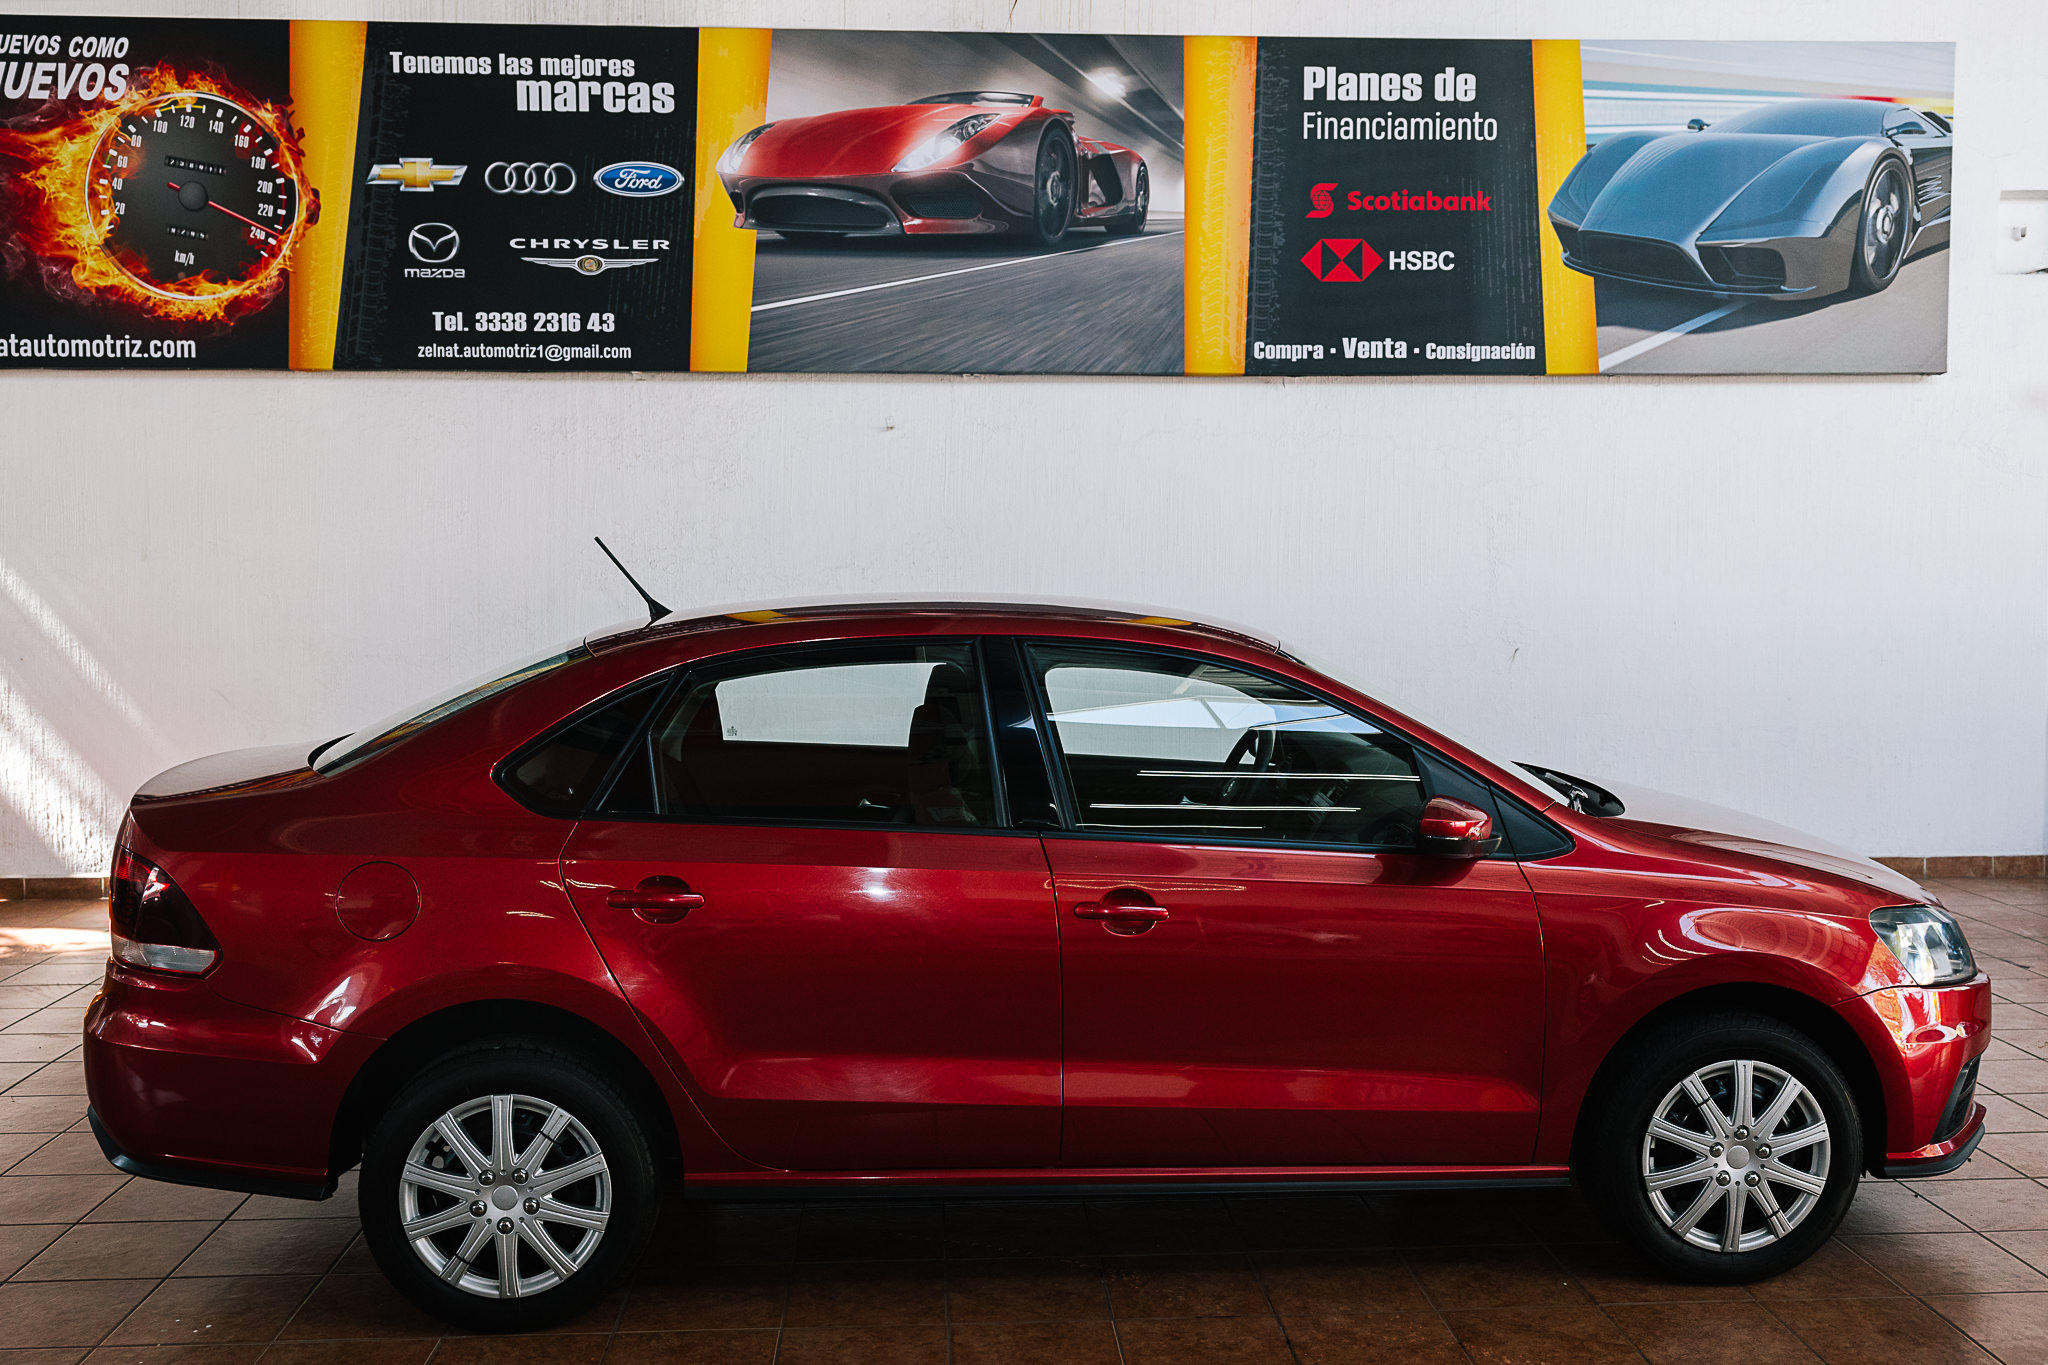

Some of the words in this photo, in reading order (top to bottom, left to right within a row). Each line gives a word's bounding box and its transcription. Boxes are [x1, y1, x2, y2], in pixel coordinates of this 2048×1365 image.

[68, 35, 130, 59] COMO
[389, 51, 492, 75] Tenemos
[498, 53, 533, 75] las
[540, 54, 636, 79] mejores
[1303, 65, 1423, 102] Planes
[1434, 66, 1477, 102] de
[516, 79, 675, 114] marcas
[153, 119, 168, 134] 100
[180, 114, 196, 129] 120
[208, 119, 224, 134] 140
[1303, 110, 1498, 141] Financiamiento
[130, 134, 142, 148] 80
[234, 134, 250, 148] 160
[117, 155, 128, 169] 60
[251, 156, 266, 170] 180
[112, 177, 123, 190] 40
[614, 167, 662, 190] Ford
[256, 180, 273, 194] 200
[114, 202, 126, 215] 20
[1347, 189, 1492, 212] Scotiabank
[257, 203, 274, 217] 220
[509, 237, 670, 250] CHRYSLER
[174, 249, 195, 266] km/h
[1389, 250, 1455, 271] HSBC
[431, 311, 469, 332] Tel.
[475, 311, 528, 332] 3338
[533, 312, 581, 333] 2316
[586, 312, 616, 333] 43
[417, 342, 632, 362] zelnat.automotriz1@gmail.com
[1253, 341, 1324, 362] Compra
[1341, 337, 1408, 359] Venta
[1425, 342, 1536, 362] Consignación
